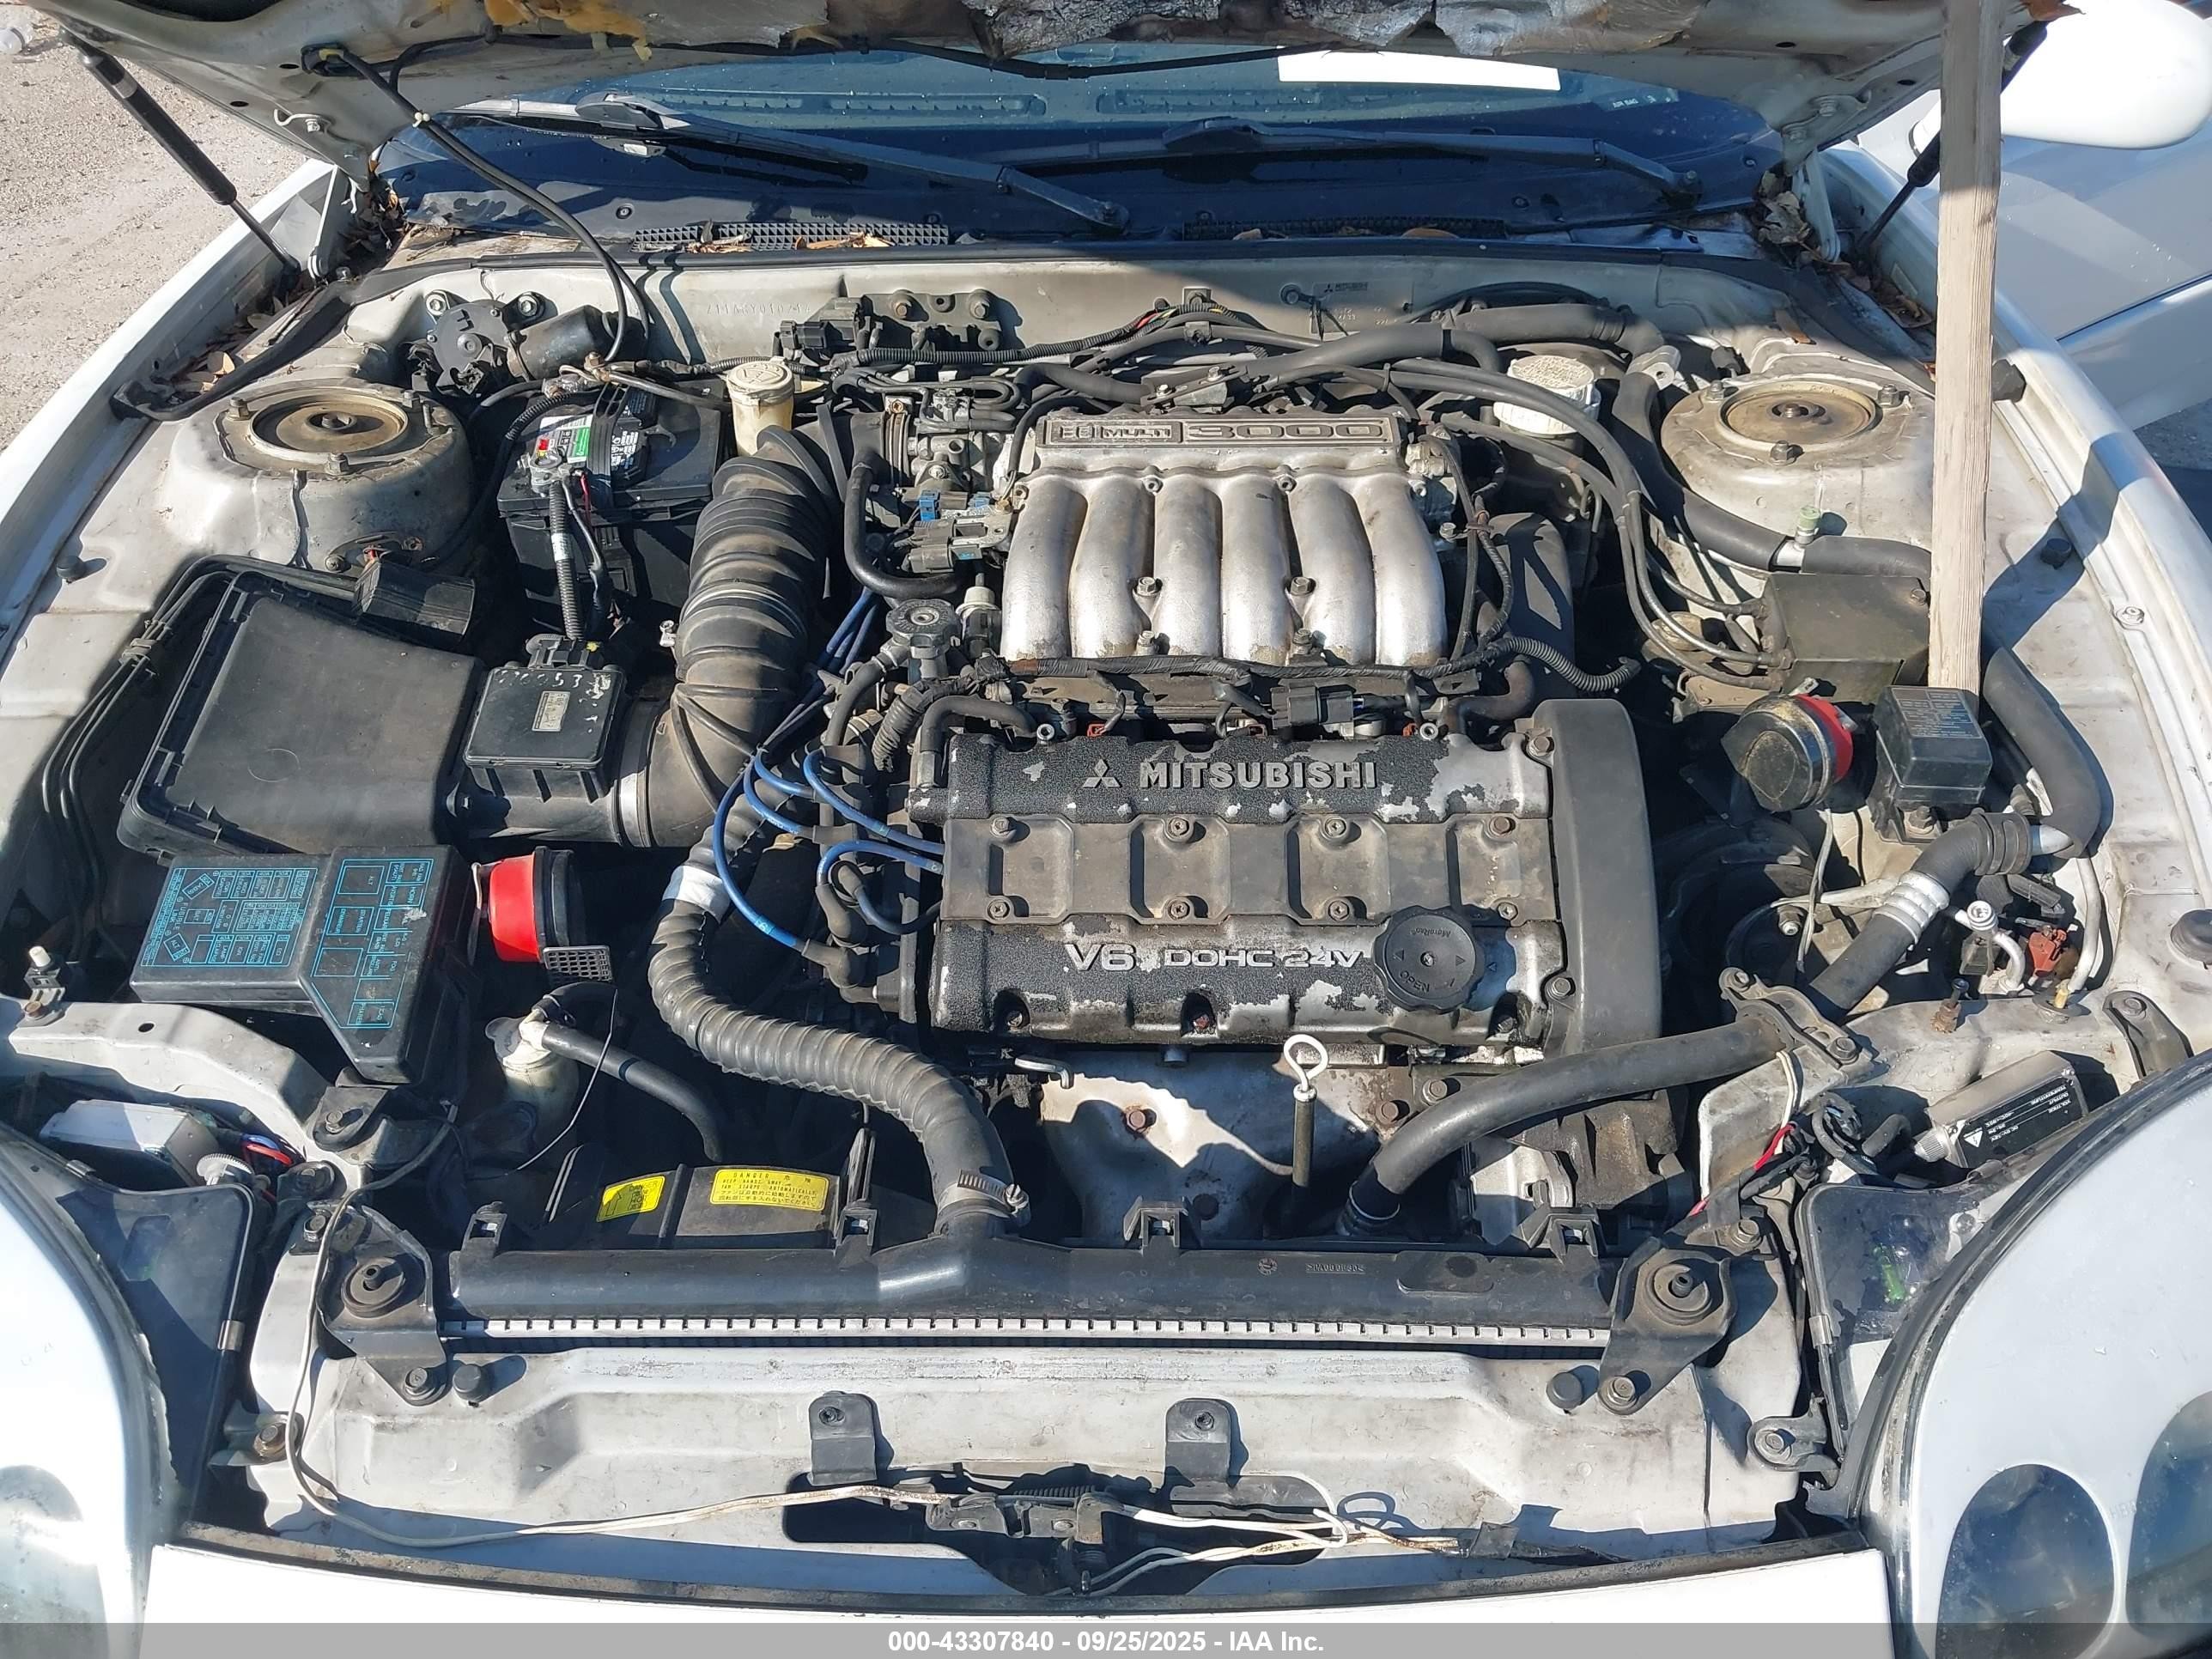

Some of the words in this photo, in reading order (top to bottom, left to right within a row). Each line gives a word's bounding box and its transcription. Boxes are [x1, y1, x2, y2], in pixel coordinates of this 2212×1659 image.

[1100, 425, 1171, 439] MULTI
[1188, 424, 1382, 439] 3000
[1140, 762, 1378, 789] MITSUBISHI
[406, 886, 416, 902] HORN
[168, 909, 179, 922] LINK
[172, 902, 188, 931] FUSIBLE
[1066, 944, 1137, 971] V6
[1165, 948, 1275, 968] DOHC
[1283, 949, 1364, 969] 24V
[1400, 970, 1430, 994] OPEN
[2047, 1091, 2069, 1105] OUTPUT
